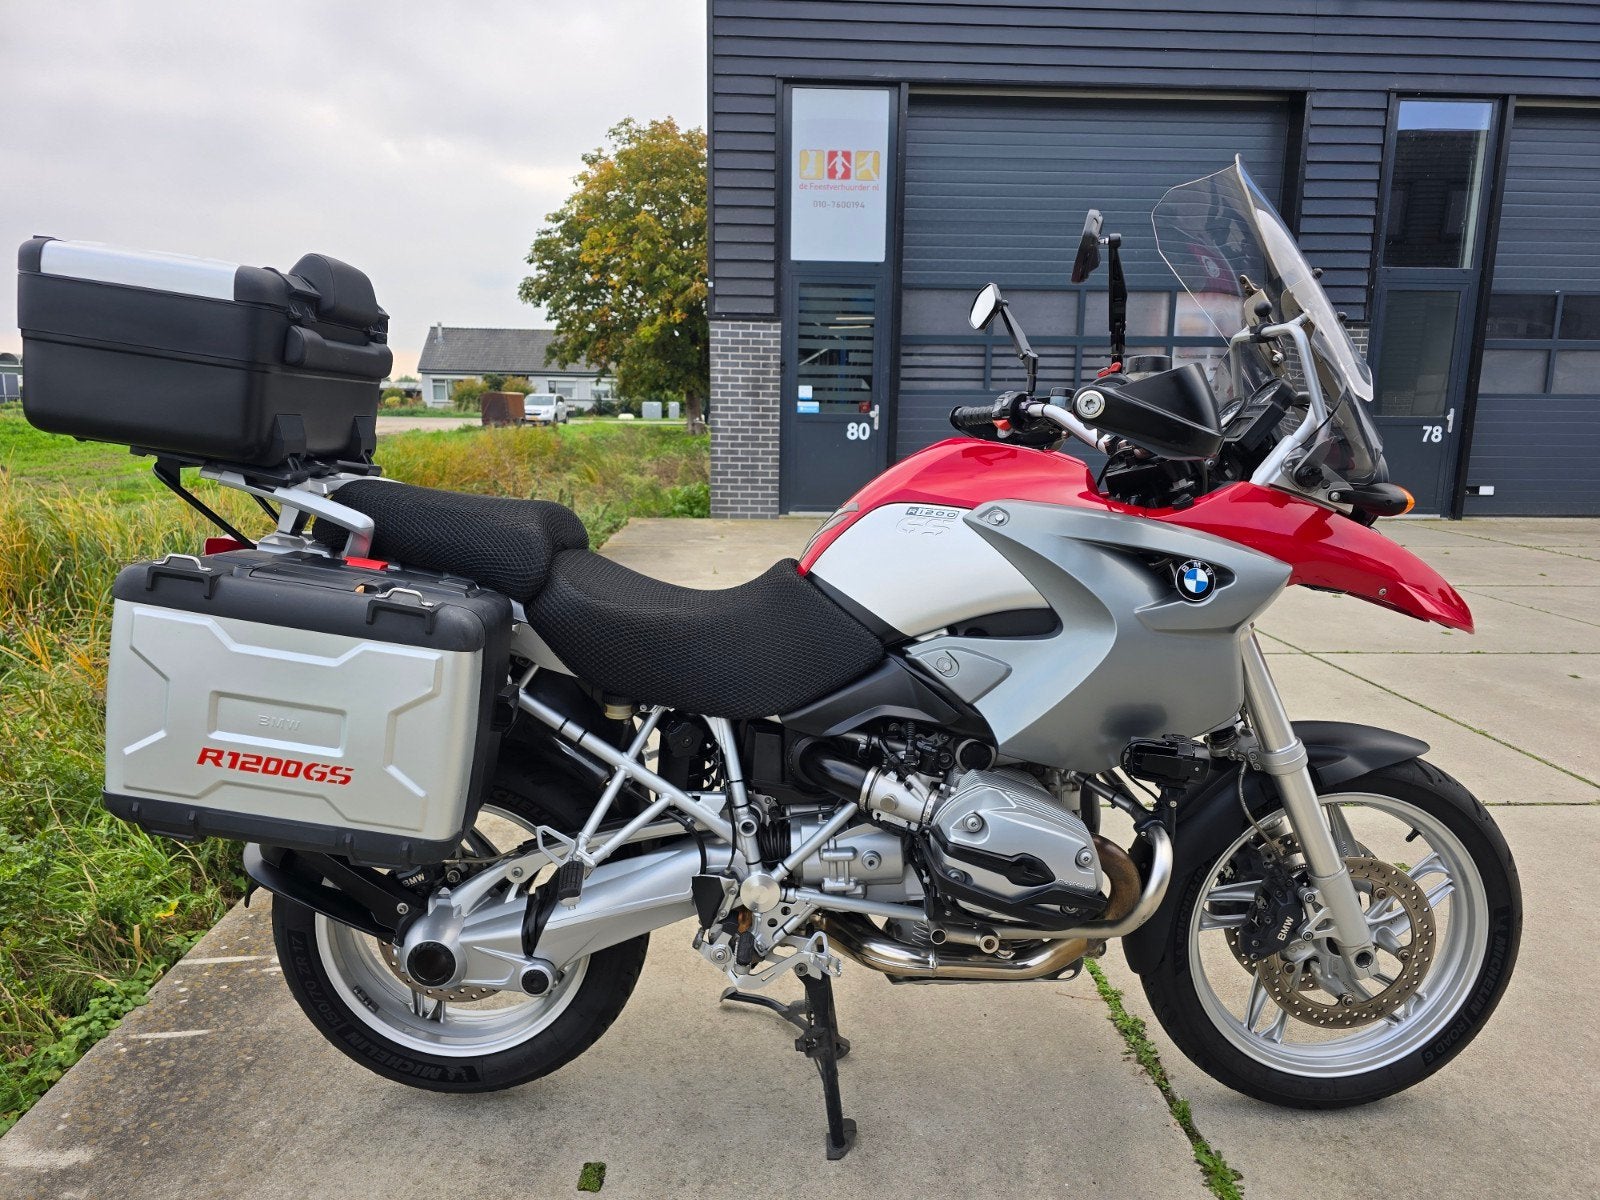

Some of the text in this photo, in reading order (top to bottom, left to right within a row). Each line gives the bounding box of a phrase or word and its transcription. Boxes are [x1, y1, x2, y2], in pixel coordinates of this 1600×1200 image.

[813, 200, 865, 209] 010-7600194
[846, 422, 871, 440] 80
[1422, 425, 1443, 443] 78
[257, 713, 302, 732] BMW
[196, 747, 355, 786] R1200GS
[402, 872, 425, 887] BMW
[1276, 916, 1294, 941] BMW
[1470, 934, 1507, 1015] MICHELIN
[345, 1029, 442, 1080] MICHELIN
